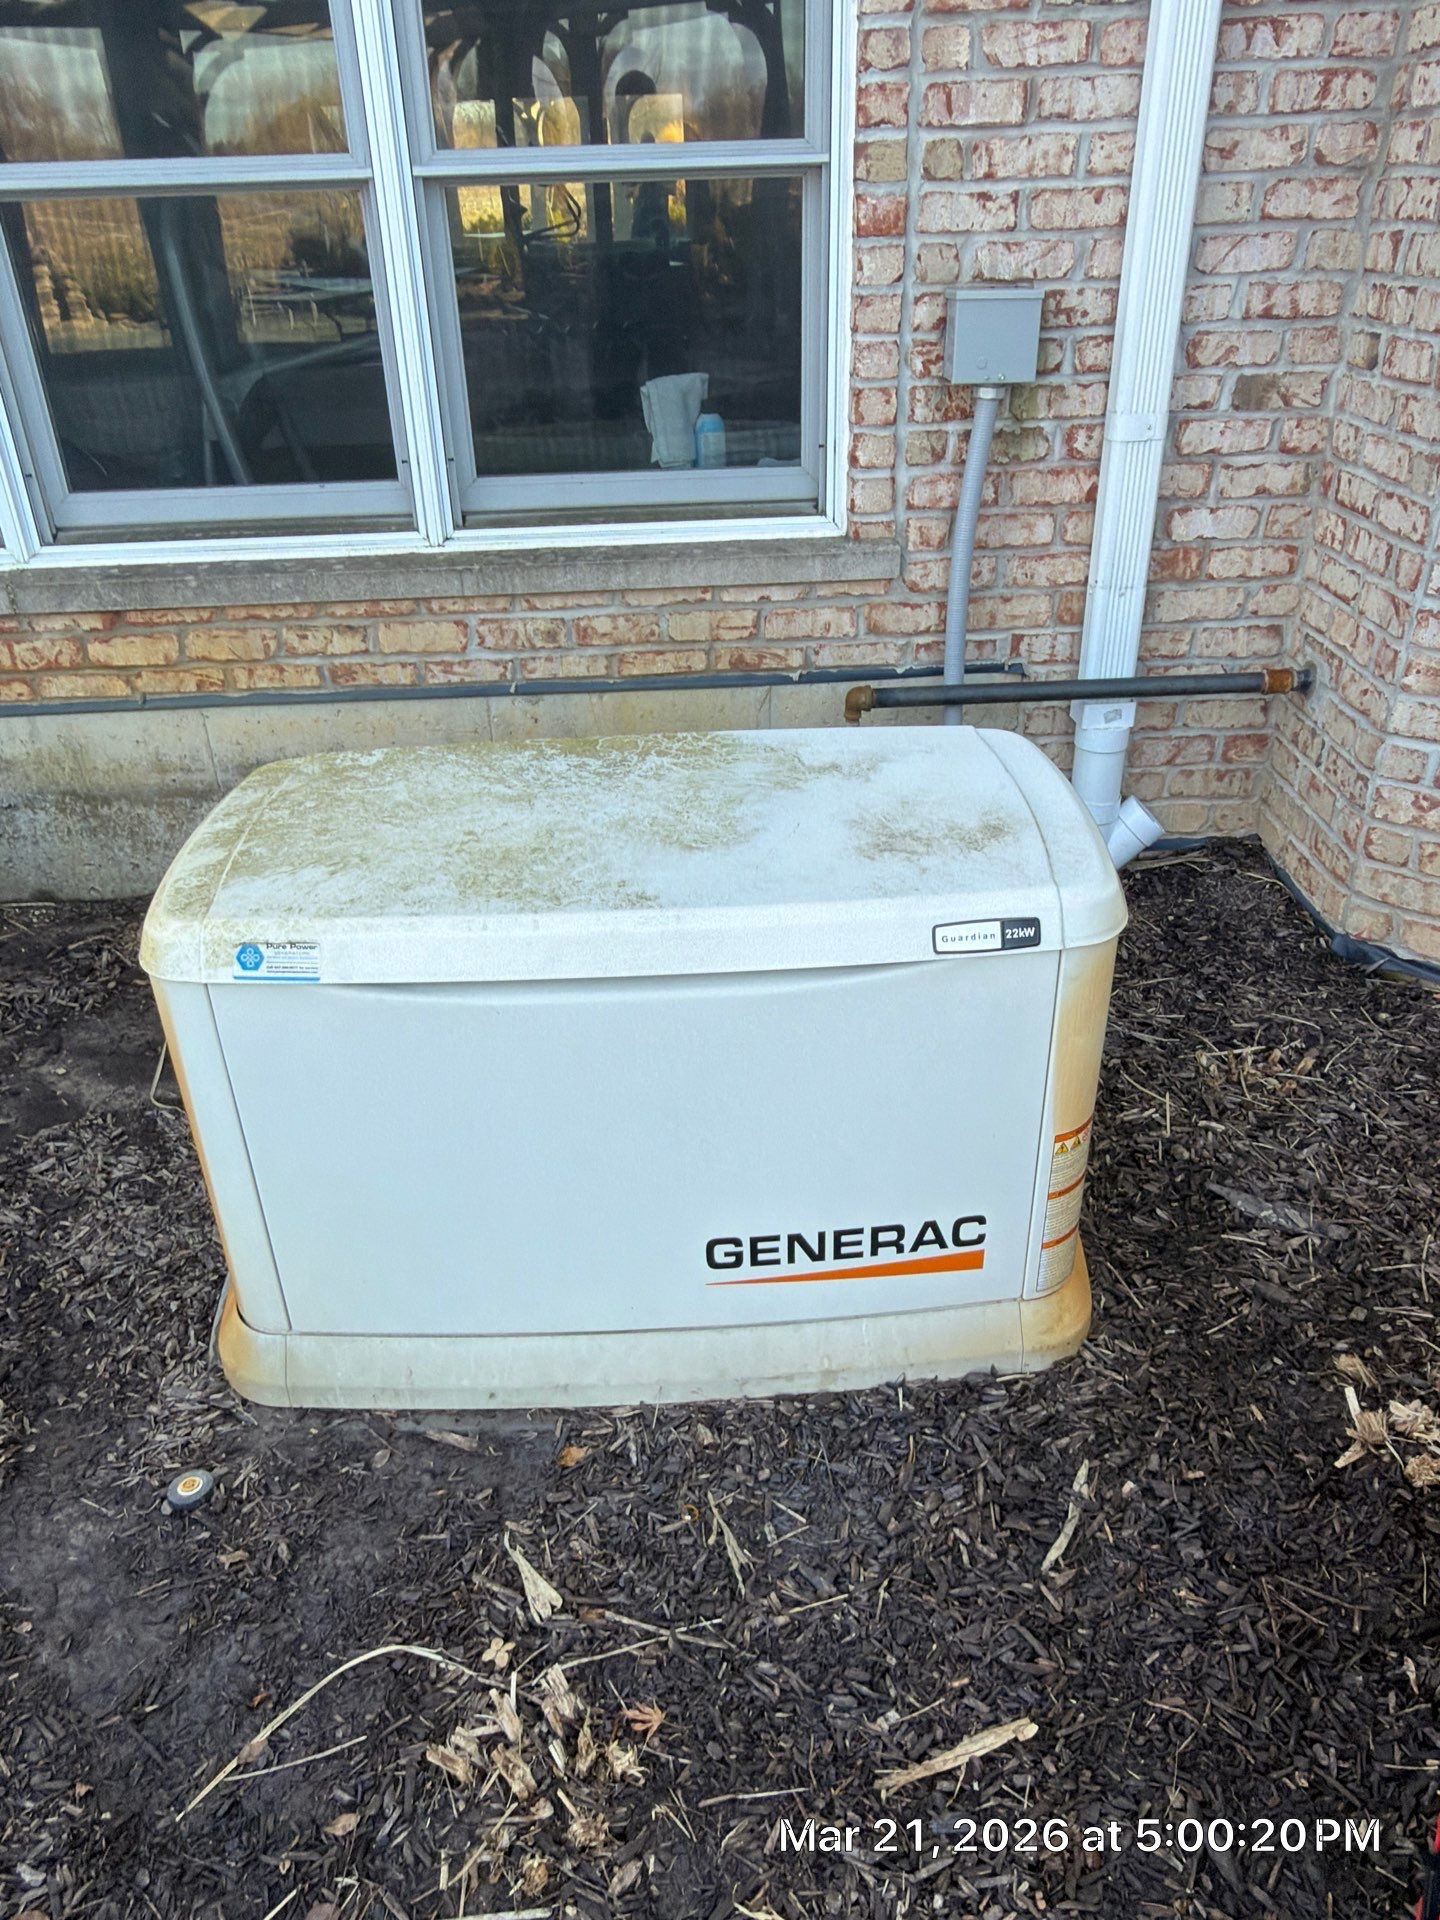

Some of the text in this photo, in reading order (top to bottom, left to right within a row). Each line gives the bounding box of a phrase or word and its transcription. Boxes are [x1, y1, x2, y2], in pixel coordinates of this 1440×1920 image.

[941, 926, 1036, 943] Guardian 22kW
[705, 1214, 987, 1270] GENERAC
